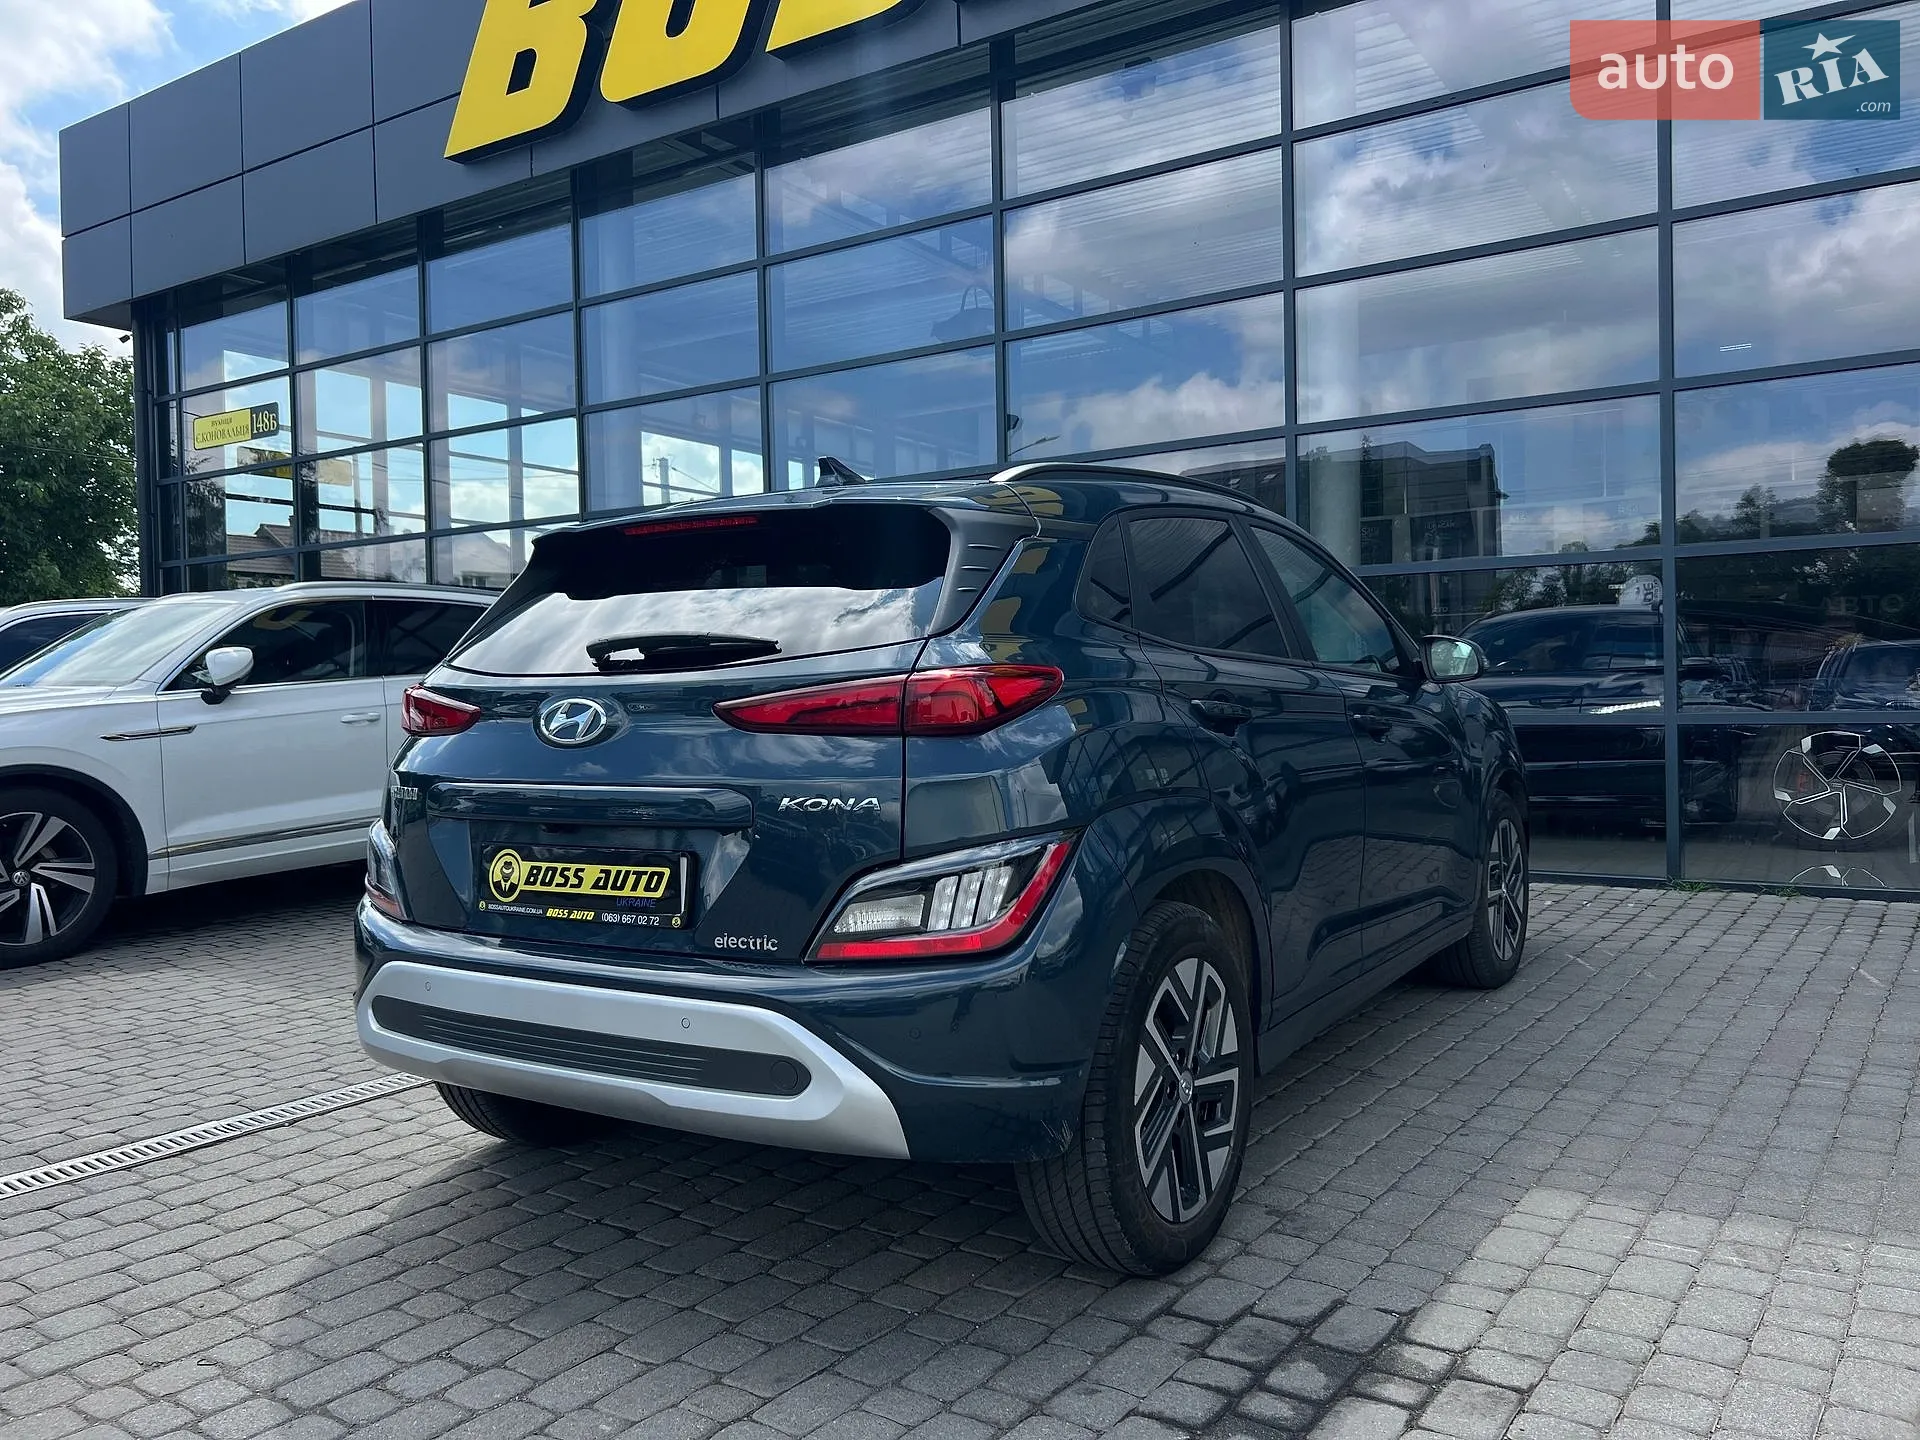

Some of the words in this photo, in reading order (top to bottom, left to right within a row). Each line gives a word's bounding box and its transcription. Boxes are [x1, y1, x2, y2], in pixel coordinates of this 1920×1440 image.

[252, 410, 277, 434] 148Б
[778, 796, 881, 812] KONA
[524, 865, 586, 889] BOSS
[590, 868, 666, 893] AUTO
[616, 897, 657, 908] UKRAINE
[546, 908, 568, 918] BOSS
[569, 910, 595, 920] AUTO
[601, 912, 620, 924] (063)
[621, 914, 636, 924] 667
[637, 915, 648, 925] 02
[649, 916, 660, 926] 72
[714, 932, 779, 951] electric
